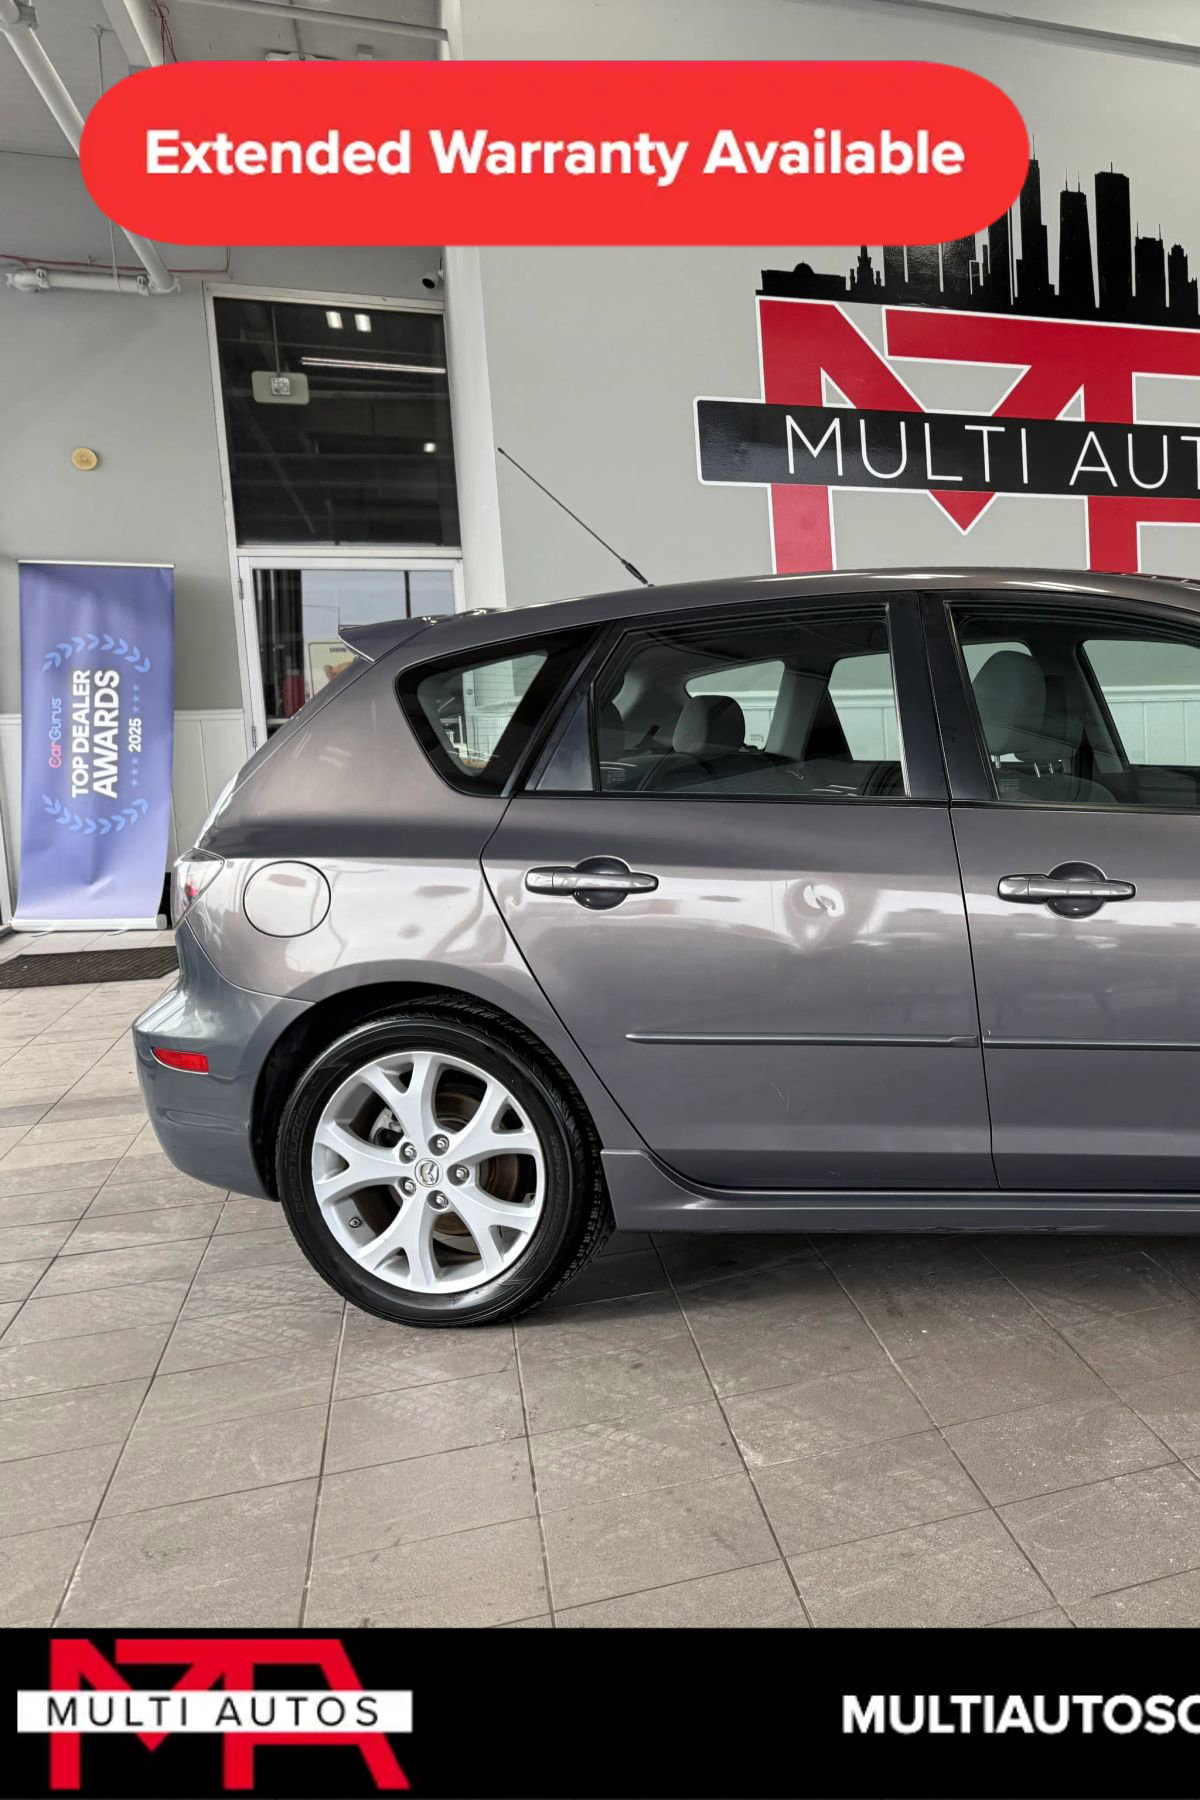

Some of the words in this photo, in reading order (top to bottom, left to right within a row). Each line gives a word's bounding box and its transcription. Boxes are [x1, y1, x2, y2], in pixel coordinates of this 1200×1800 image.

[785, 414, 1029, 484] MULTI
[48, 697, 62, 768] CarGurus
[72, 670, 91, 753] DEALER
[93, 670, 120, 799] AWARDS
[128, 718, 142, 752] 2025
[72, 756, 89, 798] TOP
